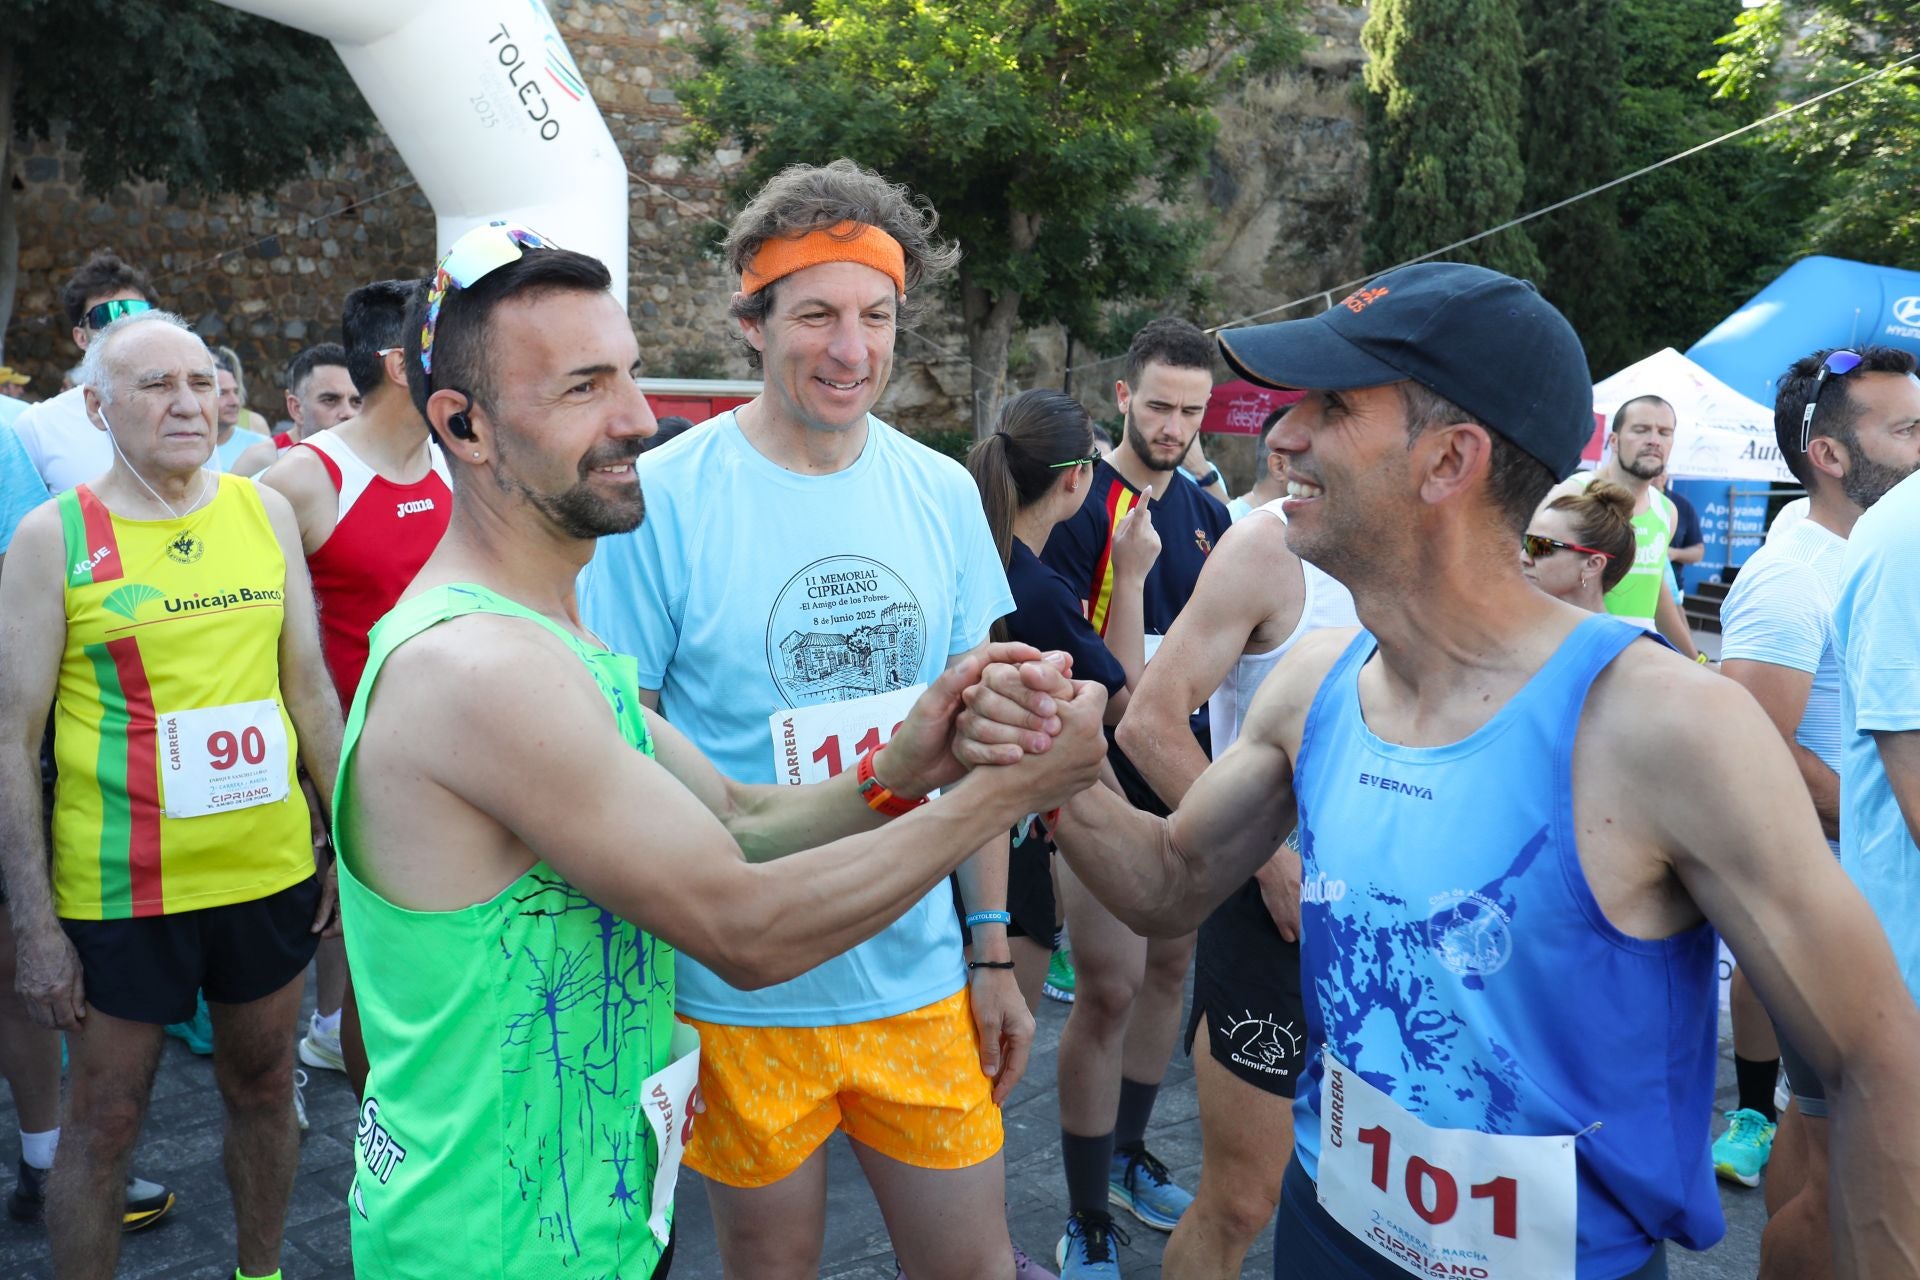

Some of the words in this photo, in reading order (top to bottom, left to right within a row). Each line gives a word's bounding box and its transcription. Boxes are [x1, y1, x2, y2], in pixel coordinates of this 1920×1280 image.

[489, 23, 560, 141] TOLEDO
[470, 93, 499, 129] 2025
[397, 498, 435, 518] Joma
[1700, 517, 1713, 528] la
[807, 579, 878, 599] CIPRIANO
[820, 569, 878, 585] MEMORIAL
[164, 588, 239, 613] Unicaja
[239, 588, 282, 601] Banco
[812, 600, 836, 610] Amigo
[838, 597, 848, 606] de
[850, 595, 862, 604] los
[813, 616, 819, 625] 8
[830, 612, 854, 625] Junio
[855, 610, 876, 621] 2025
[167, 717, 181, 771] CARRERA
[207, 725, 266, 770] 90
[783, 717, 801, 786] CARRERA
[812, 720, 907, 779] 11
[211, 786, 269, 804] CIPRIANO
[1359, 773, 1433, 800] EVERNYA
[1231, 1053, 1288, 1076] QuimiFarma
[1331, 1069, 1344, 1149] CARRERA
[1358, 1124, 1517, 1240] 101
[1373, 1226, 1488, 1279] CIPRIANO
[1386, 1219, 1429, 1249] CARRERA
[1441, 1247, 1489, 1262] MARCHA
[1379, 1241, 1408, 1261] AMIGO
[1411, 1260, 1422, 1271] DE
[1424, 1269, 1445, 1280] LOS
